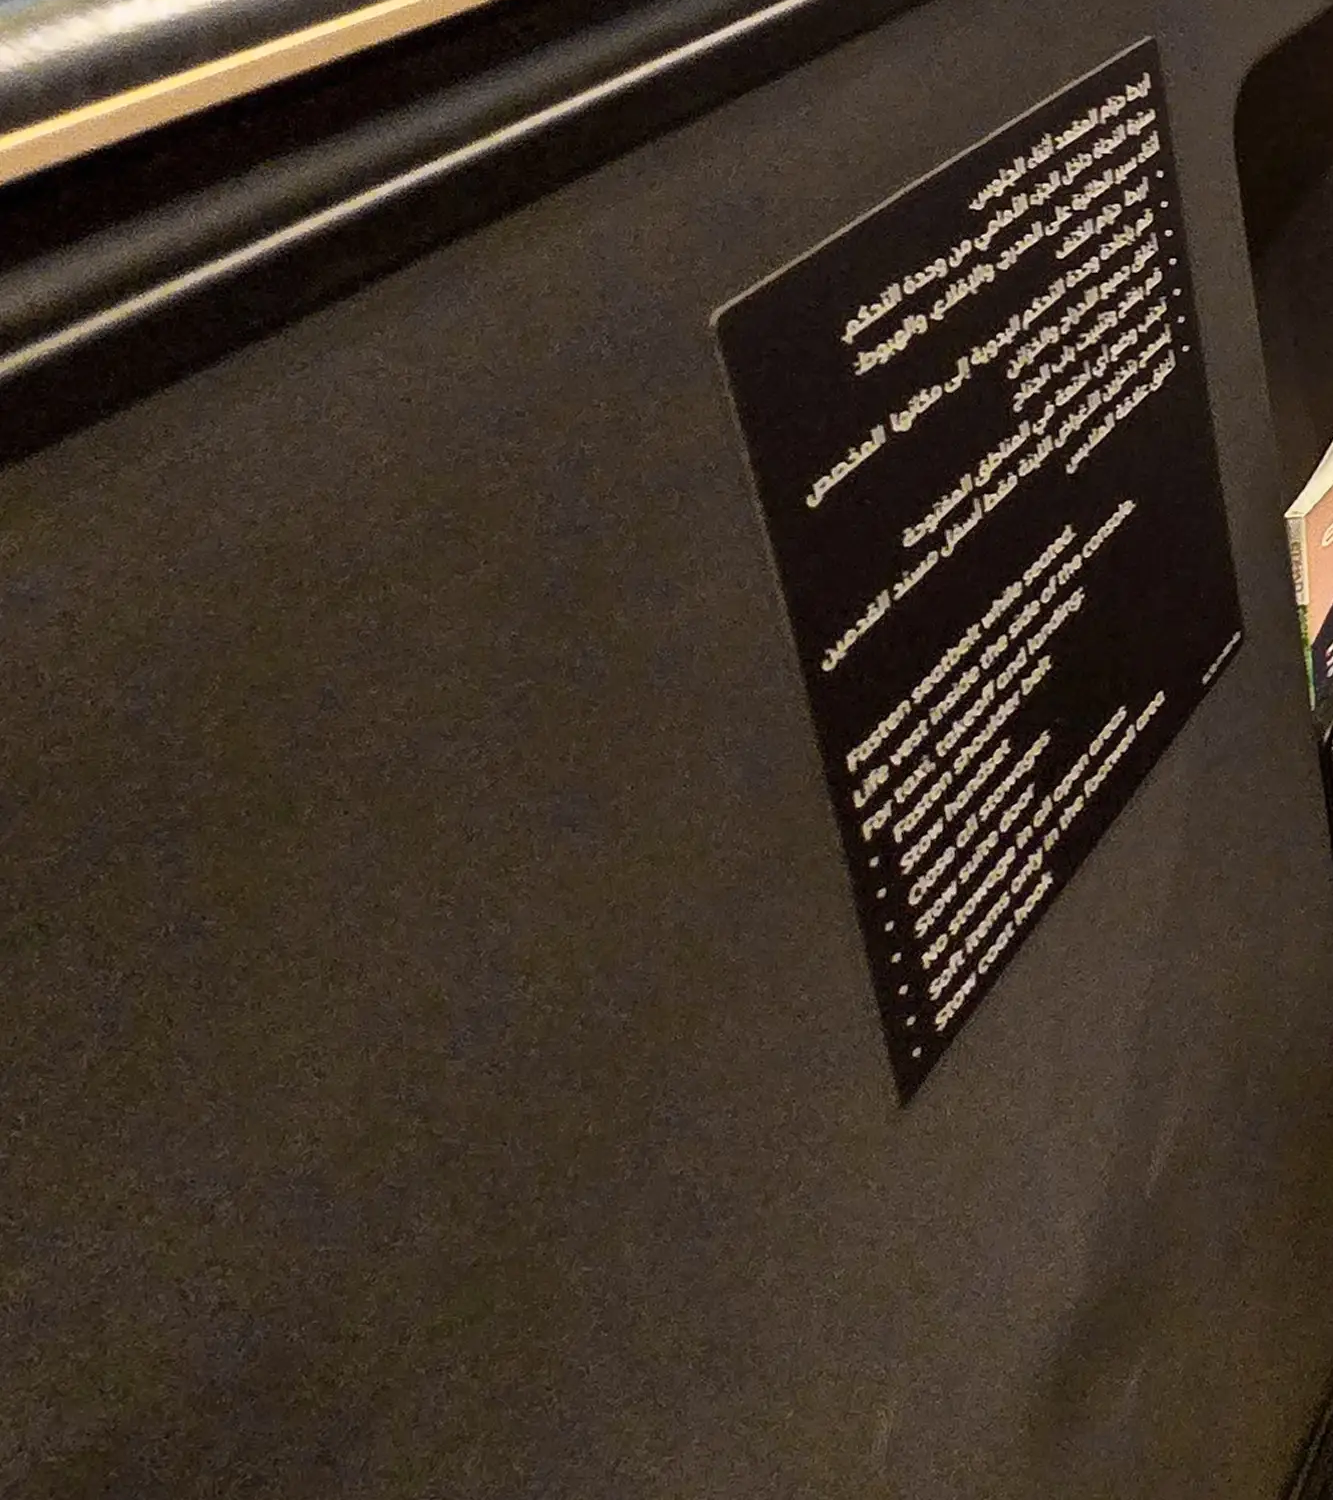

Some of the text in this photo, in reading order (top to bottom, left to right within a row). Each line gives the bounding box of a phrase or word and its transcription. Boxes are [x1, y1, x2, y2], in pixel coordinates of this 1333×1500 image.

[846, 700, 912, 772] Fasten
[911, 623, 982, 704] seatbelt
[981, 581, 1023, 629] while
[853, 765, 889, 808] Life
[889, 719, 929, 766] vest
[929, 666, 980, 725] inside
[979, 634, 1008, 670] the
[1008, 600, 1040, 639] side
[1040, 575, 1057, 604] of
[1056, 554, 1082, 585] the
[862, 799, 891, 841] For
[894, 755, 936, 803] taxi,
[935, 679, 995, 757] takeoff
[996, 646, 1027, 690] and
[893, 655, 1052, 843] Fasten shoulder belt
[900, 738, 1011, 874] Stow handset
[908, 730, 1051, 906] Close all stowages
[915, 783, 1035, 938] Stow suite door
[921, 706, 1127, 969] No stowage in all open areas
[928, 691, 1165, 1000] Soft items only in the footwell area
[935, 871, 1053, 1031] Stow coat hook
